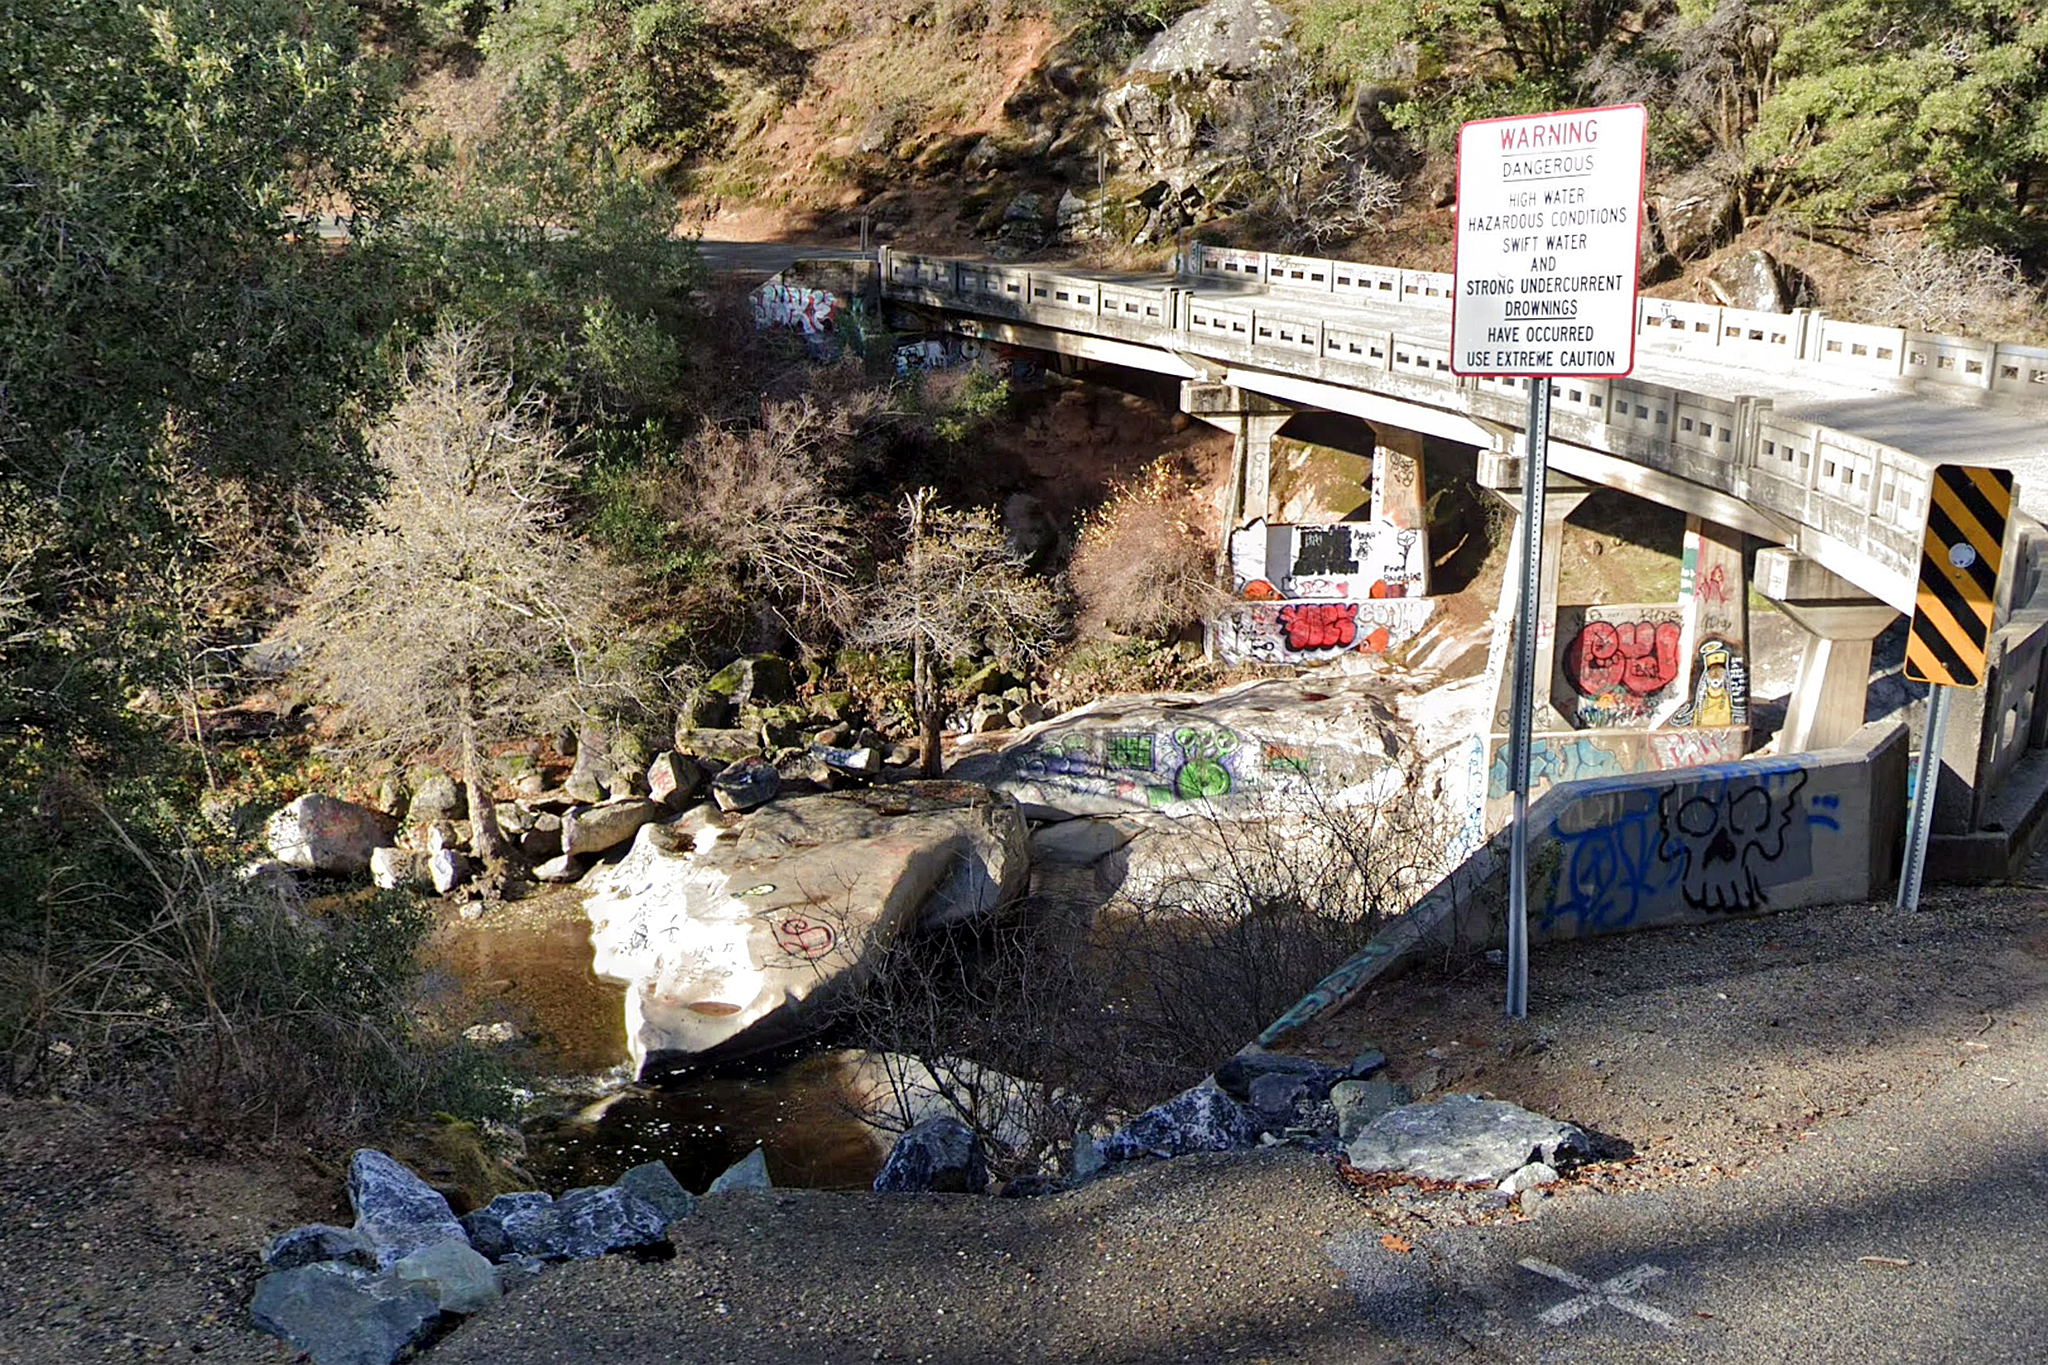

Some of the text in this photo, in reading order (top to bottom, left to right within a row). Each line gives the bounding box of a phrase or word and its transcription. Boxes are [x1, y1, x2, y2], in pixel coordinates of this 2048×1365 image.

[1500, 119, 1598, 150] WARNING
[1502, 155, 1594, 177] DANGEROUS
[1509, 187, 1585, 207] HIGH WATER
[1468, 206, 1627, 232] HAZARDOUS CONDITIONS
[1502, 233, 1587, 253] SWIFT WATER
[1530, 256, 1556, 272] AND
[1466, 275, 1623, 296] STRONG UNDERCURRENT
[1505, 299, 1578, 316] DROWNINGS
[1488, 326, 1594, 343] HAVE OCCURRED
[1467, 350, 1615, 367] USE EXTREME CAUTION
